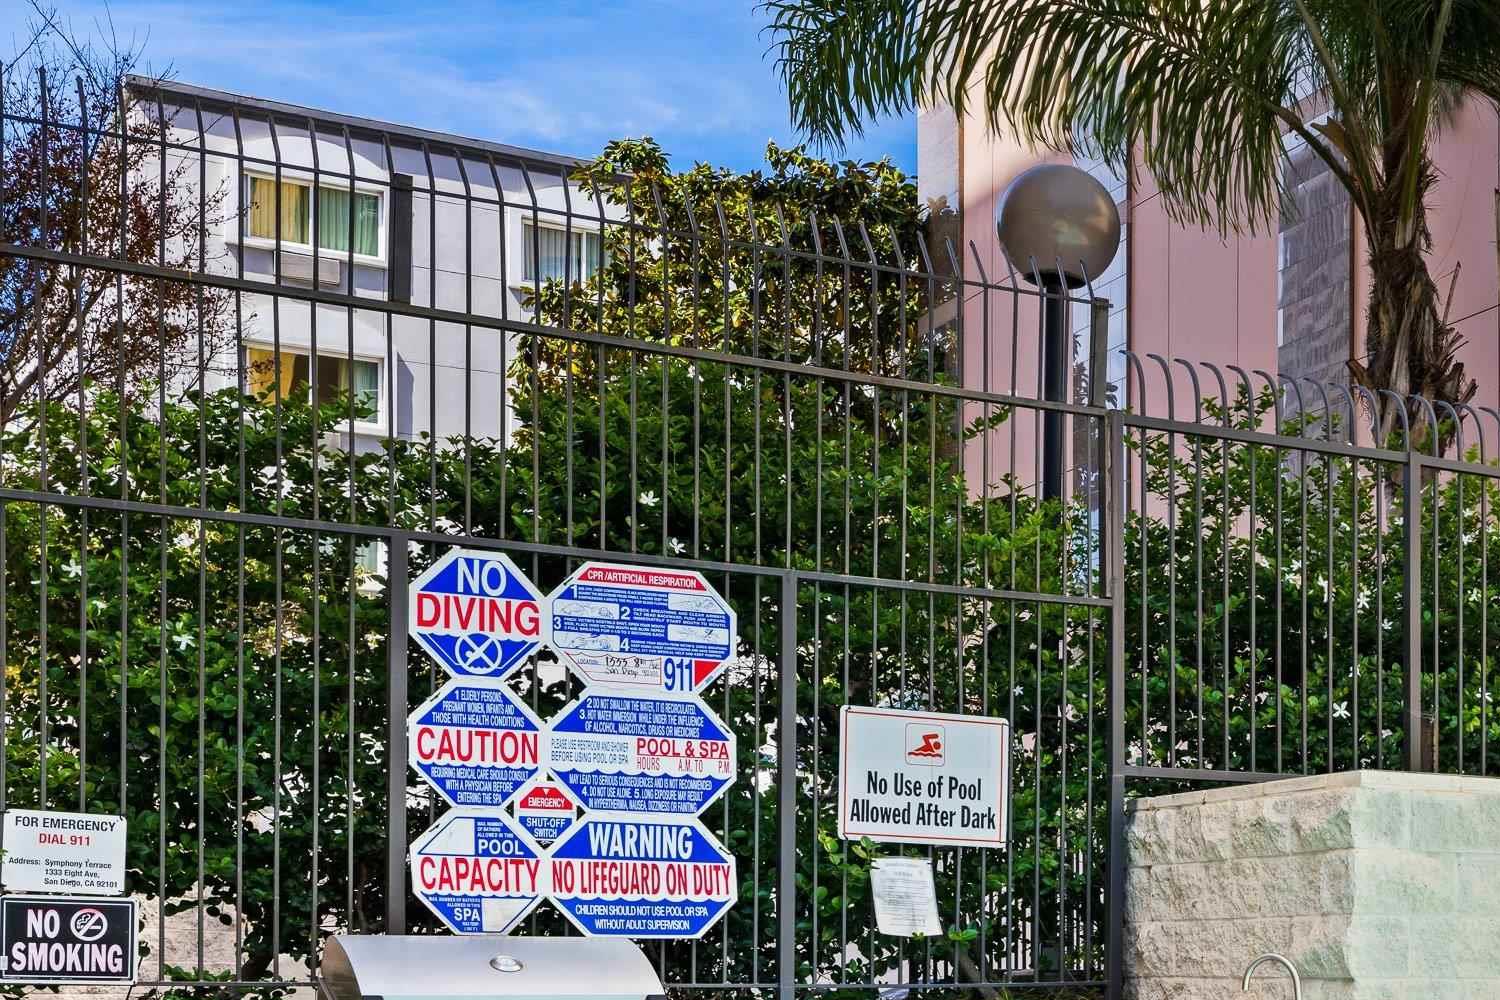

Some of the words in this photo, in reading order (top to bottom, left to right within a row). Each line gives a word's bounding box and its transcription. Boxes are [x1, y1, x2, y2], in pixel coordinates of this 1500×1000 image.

[457, 557, 506, 596] NO
[587, 570, 603, 580] CPR
[649, 576, 696, 588] RESPIRATION
[417, 593, 539, 636] DIVING
[621, 606, 631, 620] 2
[553, 616, 561, 630] 3
[621, 638, 630, 651] 4
[664, 658, 693, 692] 911
[461, 690, 480, 701] ELDERLY
[442, 701, 466, 712] PREGNANT
[485, 703, 505, 714] INFANTS
[505, 704, 515, 715] AND
[592, 697, 600, 709] DO
[600, 698, 609, 710] NOT
[610, 699, 630, 711] SWALLOW
[631, 700, 639, 712] THE
[432, 712, 451, 723] THOSE
[452, 713, 466, 724] WITH
[468, 714, 489, 726] HEALTH
[490, 715, 525, 727] CONDITIONS
[597, 710, 612, 721] WATER
[638, 713, 652, 724] WHILE
[653, 713, 667, 725] UNDER
[667, 714, 678, 725] THE
[678, 715, 704, 727] INFLUENCE
[585, 720, 593, 732] OF
[648, 725, 665, 736] DRUGS
[665, 726, 673, 737] OR
[674, 726, 700, 738] MEDICINES
[417, 727, 538, 764] CAUTION
[636, 738, 681, 757] POOL
[685, 740, 696, 757] &
[700, 741, 729, 760] SPA
[551, 750, 573, 762] BEFORE
[574, 751, 592, 763] USING
[593, 752, 608, 764] POOL
[609, 753, 617, 764] OR
[618, 754, 629, 765] SPA
[637, 757, 660, 771] HOURS
[694, 760, 703, 772] TO
[431, 767, 456, 778] REQUIRING
[456, 768, 476, 779] MEDICAL
[477, 769, 489, 780] CARE
[490, 769, 508, 781] SHOULD
[508, 770, 529, 782] CONSULT
[569, 773, 579, 784] MAY
[580, 774, 591, 785] LEAD
[592, 774, 598, 786] TO
[599, 775, 618, 787] SERIOUS
[619, 776, 654, 788] CONSEQUENCES
[654, 778, 663, 788] AND
[664, 778, 669, 789] IS
[669, 779, 678, 789] NOT
[680, 779, 712, 791] RECOMMENDED
[446, 779, 459, 790] WITH
[460, 780, 464, 791] A
[464, 780, 492, 792] PHYSICIAN
[493, 781, 513, 792] BEFORE
[867, 770, 888, 795] No
[894, 773, 922, 797] Use
[927, 775, 944, 799] of
[949, 777, 982, 801] Pool
[457, 792, 481, 803] ENTERING
[482, 793, 492, 803] THE
[590, 786, 597, 797] DO
[597, 786, 606, 798] NOT
[607, 787, 616, 798] USE
[641, 788, 654, 800] LONG
[654, 789, 678, 801] EXPOSURE
[678, 790, 687, 801] MAY
[528, 797, 565, 807] EMERGENCY
[589, 797, 594, 808] IN
[647, 801, 670, 812] DIZZINESS
[671, 801, 678, 812] OR
[850, 798, 911, 825] Allowed
[916, 802, 956, 827] After
[961, 805, 996, 830] Dark
[15, 816, 39, 828] FOR
[42, 818, 117, 832] EMERGENCY
[526, 817, 566, 828] SHUT-OFF
[39, 833, 66, 845] DIAL
[70, 835, 91, 846] 911
[534, 828, 557, 838] SWITCH
[588, 822, 694, 859] WARNING
[478, 839, 524, 855] POOL
[8, 857, 40, 866] Address:
[44, 858, 83, 869] Symphony
[84, 860, 112, 869] Terrace
[45, 869, 63, 877] 1333
[64, 870, 83, 879] Eight
[420, 856, 541, 892] CAPACITY
[552, 860, 575, 894] NO
[580, 861, 661, 895] LIFEGUARD
[666, 863, 688, 896] ON
[693, 864, 731, 896] DUTY
[44, 878, 59, 886] San
[96, 880, 118, 888] 92101
[454, 907, 480, 921] SPA
[575, 904, 608, 915] CHILDREN
[608, 905, 637, 916] SHOULD
[637, 906, 650, 916] NOT
[651, 906, 665, 916] USE
[666, 906, 684, 917] POOL
[684, 907, 695, 917] OR
[695, 907, 709, 917] SPA
[26, 909, 60, 939] NO
[595, 918, 625, 929] WITHOUT
[625, 919, 646, 930] ADULT
[647, 920, 690, 930] SUPERVISION
[11, 942, 123, 973] SMOKING
